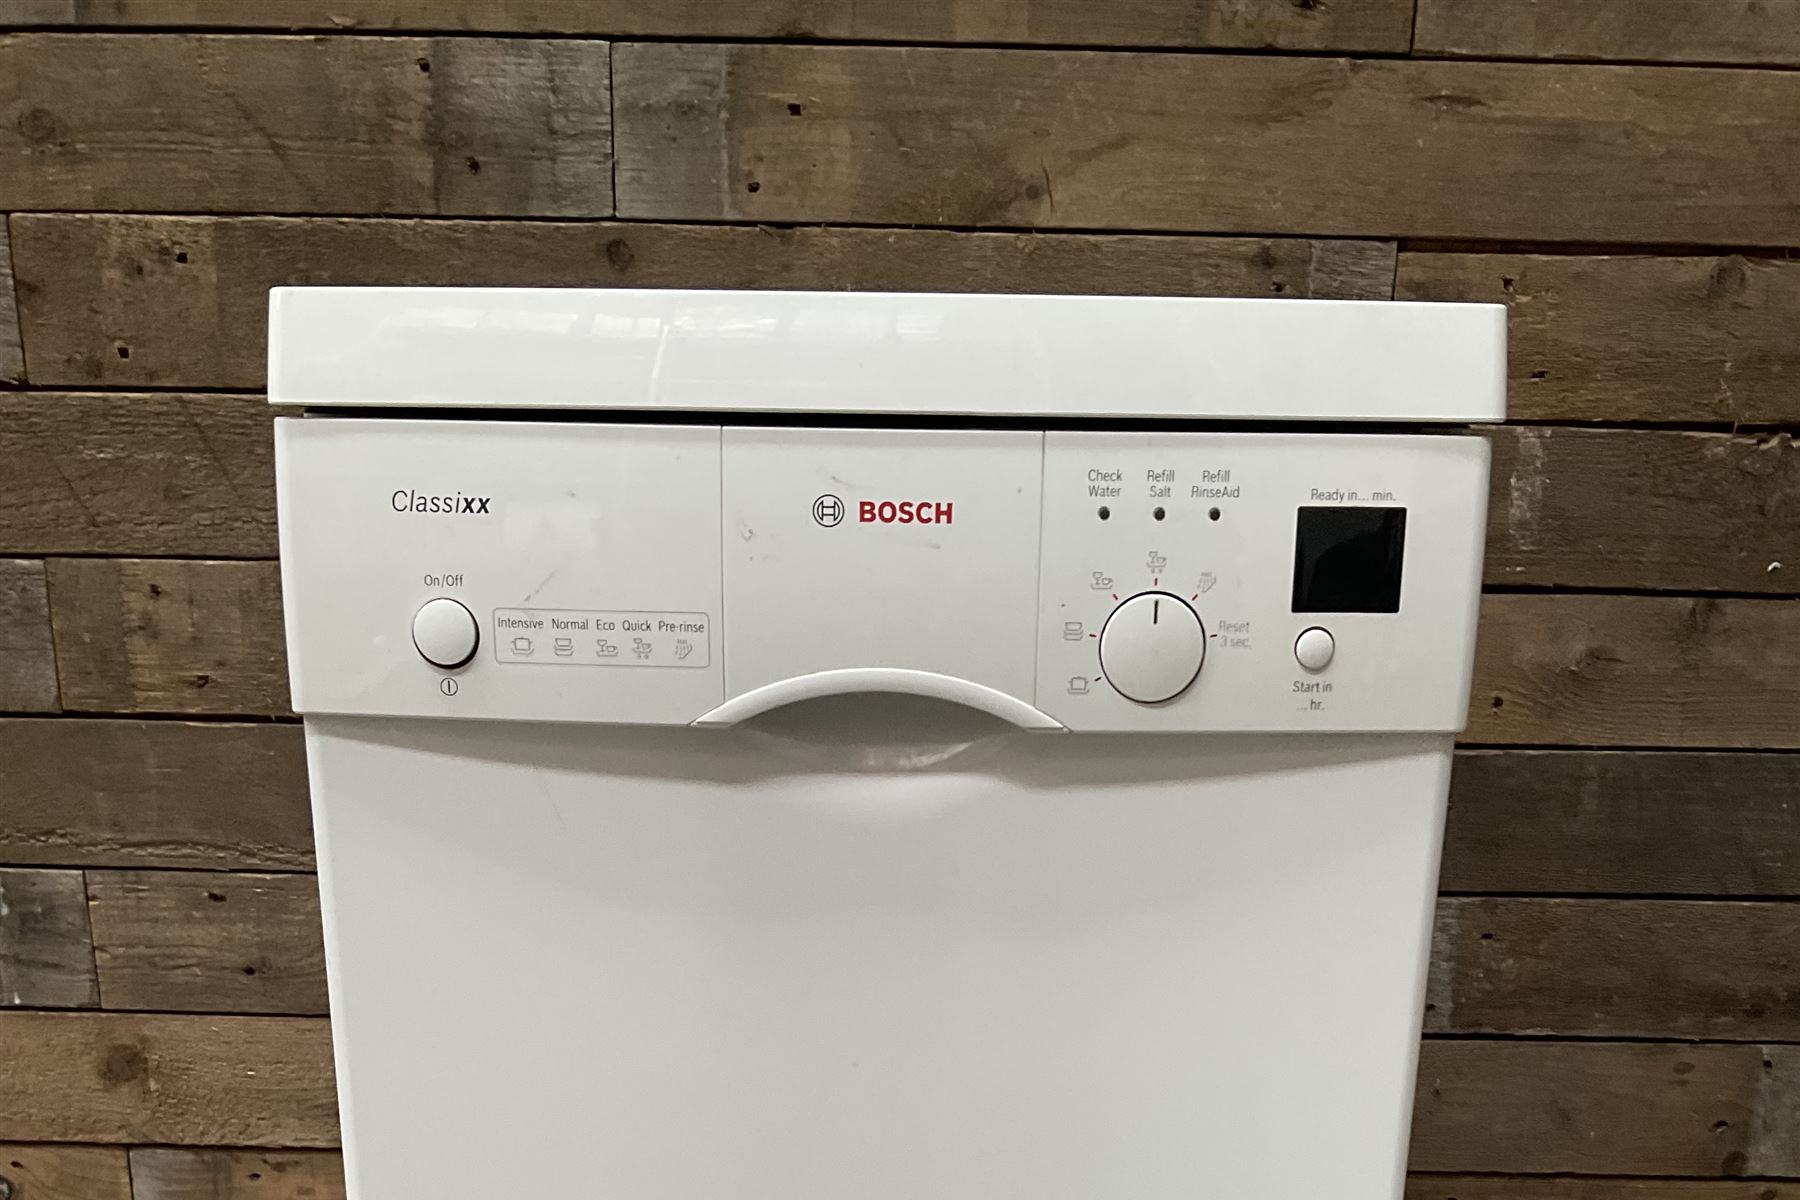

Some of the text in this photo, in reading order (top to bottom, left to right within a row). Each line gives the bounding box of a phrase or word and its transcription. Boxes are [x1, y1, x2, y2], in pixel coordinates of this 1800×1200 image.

[1088, 469, 1123, 482] Check
[1147, 470, 1175, 482] Refill
[1202, 470, 1231, 483] Refill
[1088, 485, 1122, 497] Water
[1150, 485, 1171, 498] Salt
[1310, 488, 1345, 503] Ready
[1372, 489, 1397, 501] min.
[392, 489, 491, 514] Classixx
[859, 501, 953, 524] BOSCH
[424, 574, 464, 588] On/Off
[498, 617, 705, 633] Intensive Normal Eco Quick Pre-rinse
[1219, 620, 1249, 632] Reset
[1292, 680, 1333, 693] Start in
